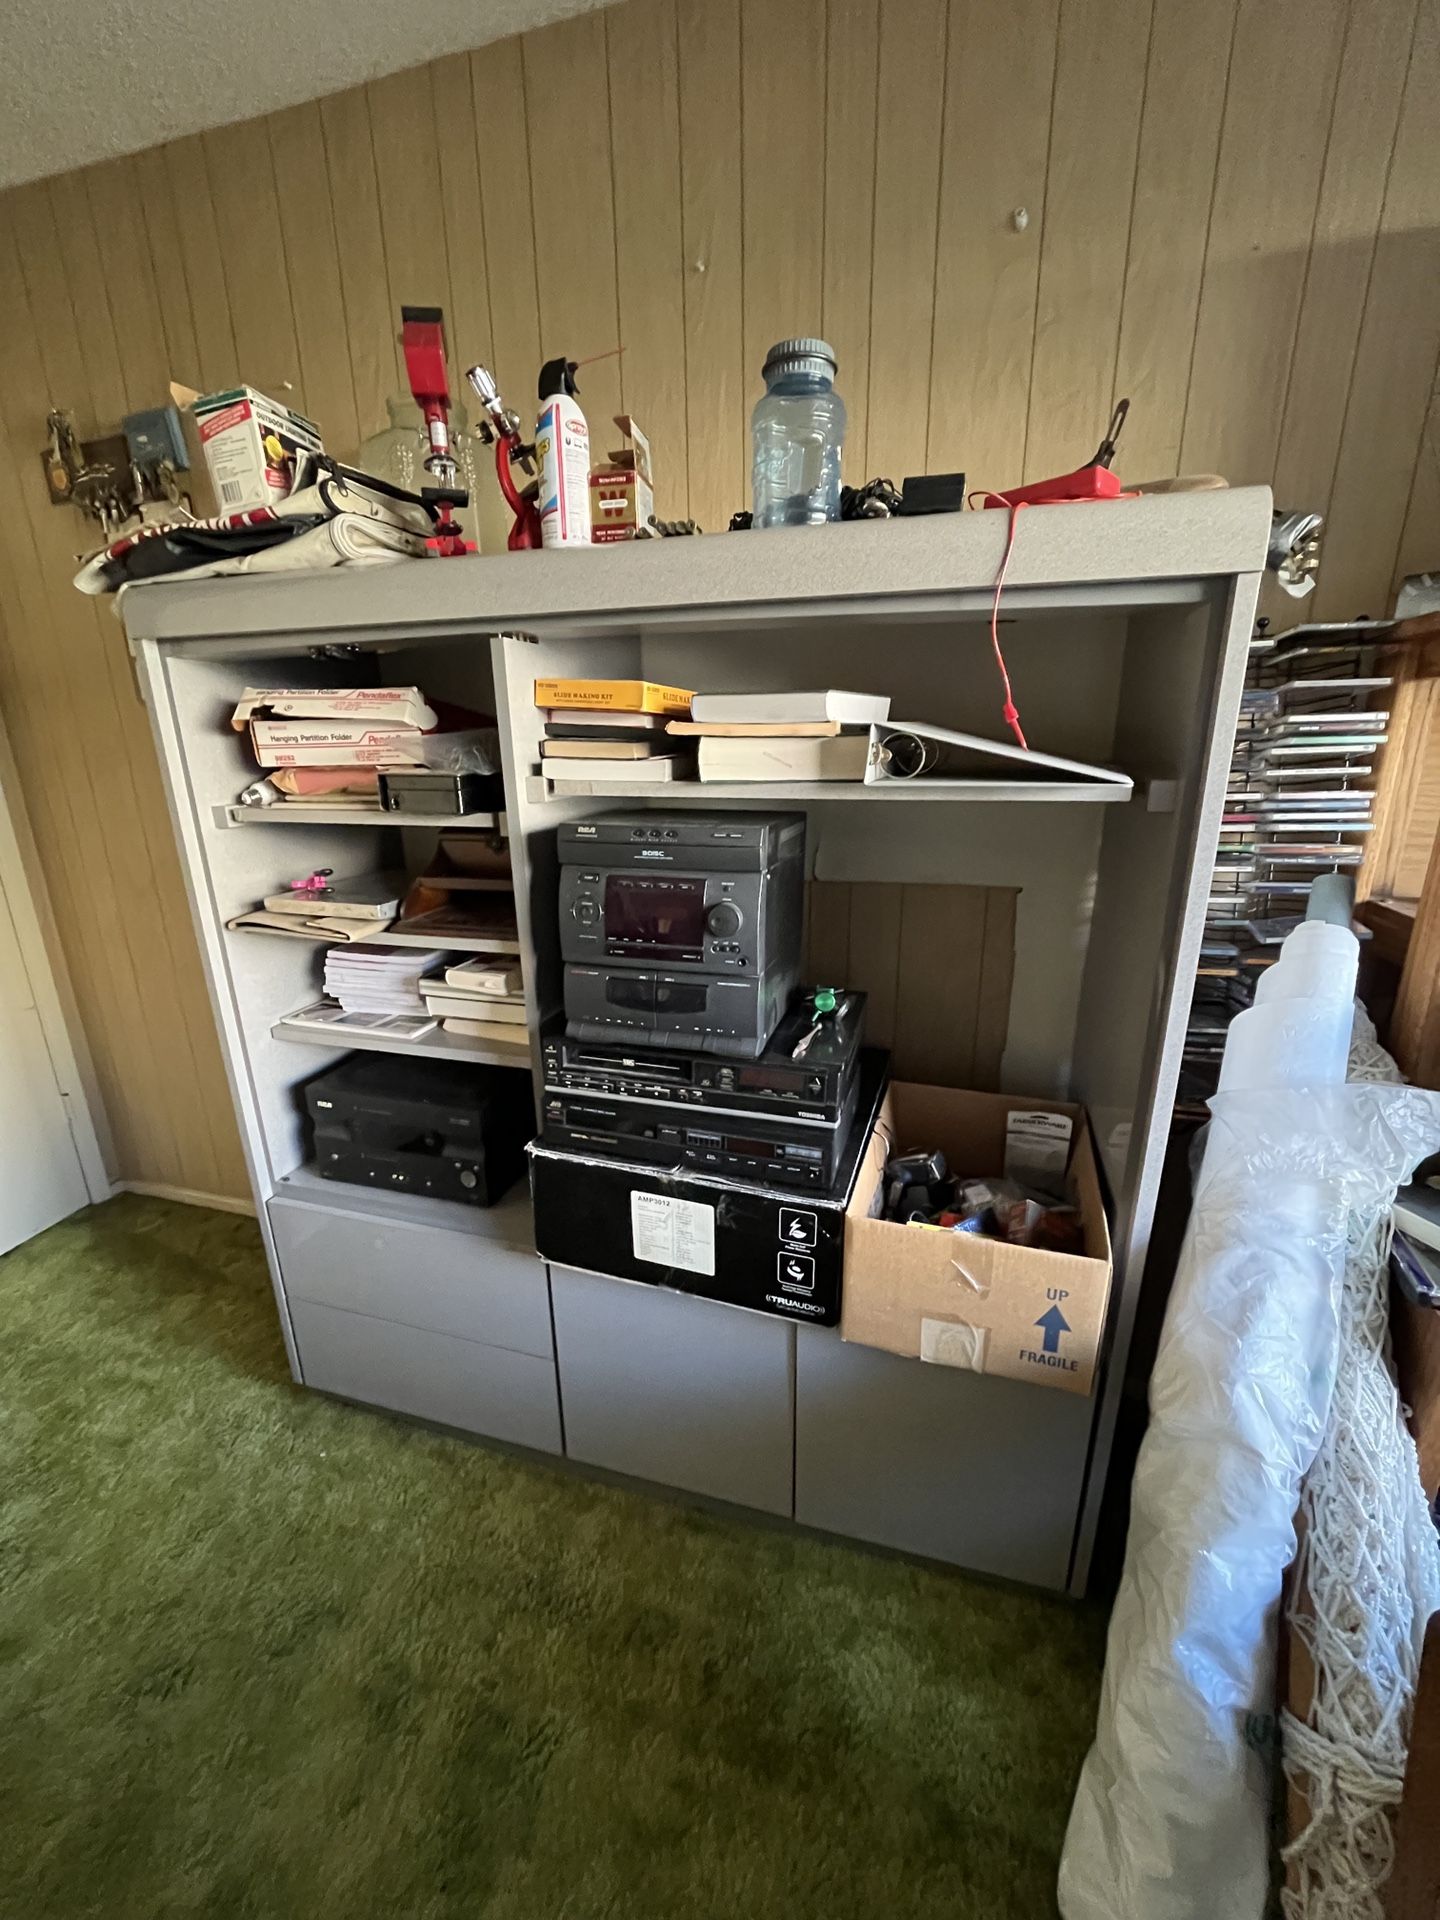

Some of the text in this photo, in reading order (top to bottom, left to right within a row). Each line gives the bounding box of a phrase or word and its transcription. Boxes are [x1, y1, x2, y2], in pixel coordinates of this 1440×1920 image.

[600, 693, 613, 701] KIT
[270, 733, 352, 744] Hanging Partition Folder
[797, 1111, 826, 1120] TOSHIBA
[637, 1195, 671, 1207] AMP3012
[1046, 1287, 1070, 1301] UP
[1018, 1349, 1079, 1372] FRAGILE
